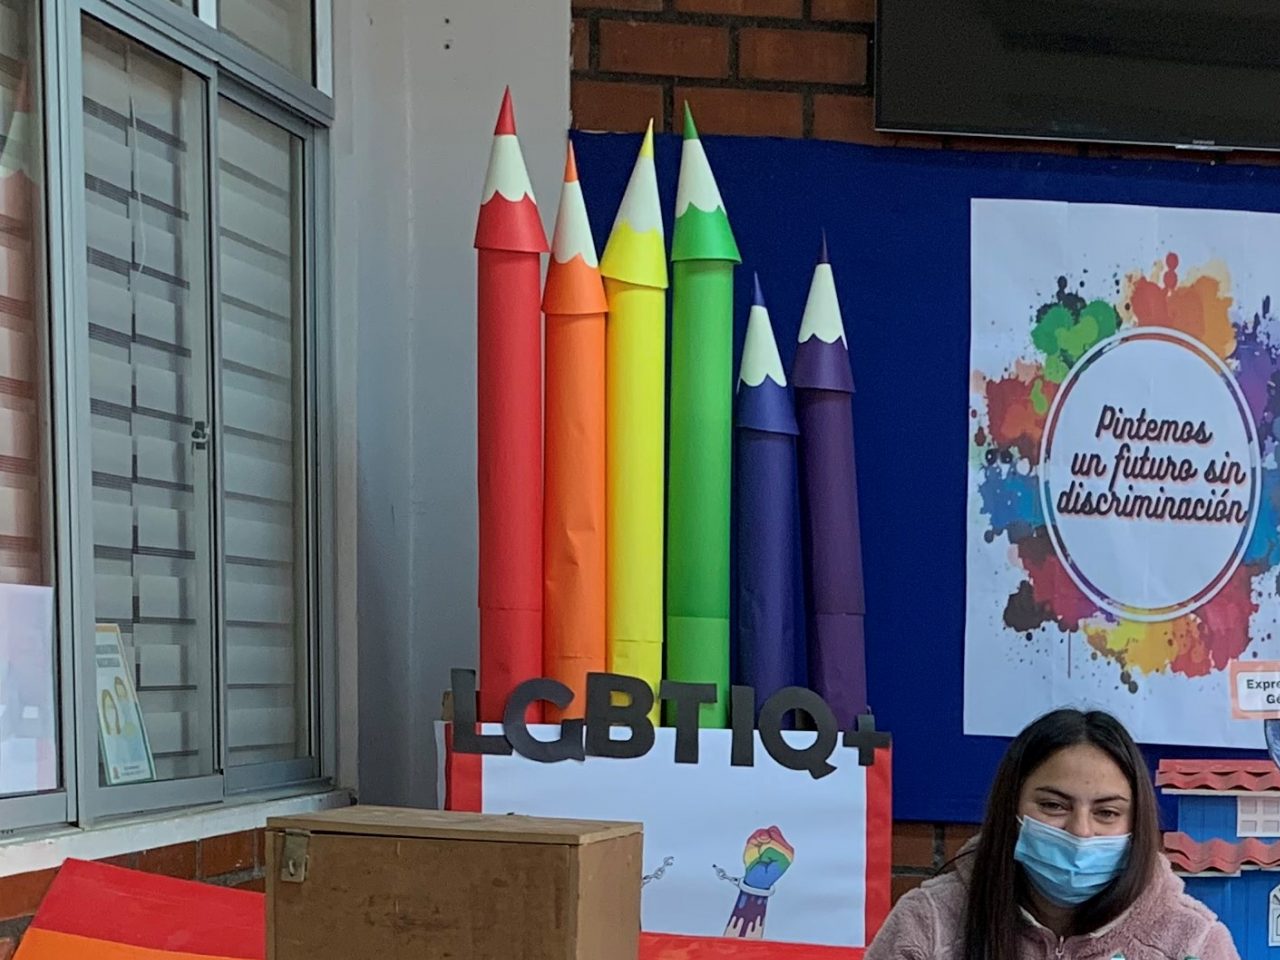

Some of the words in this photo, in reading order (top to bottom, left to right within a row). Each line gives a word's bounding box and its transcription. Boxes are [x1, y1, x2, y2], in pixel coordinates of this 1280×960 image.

[1095, 404, 1213, 444] Pintemos
[1071, 451, 1107, 477] un
[1108, 443, 1198, 491] futuro
[1204, 451, 1246, 485] sin
[1057, 480, 1249, 524] discriminación
[450, 667, 892, 780] LGBTIQ+
